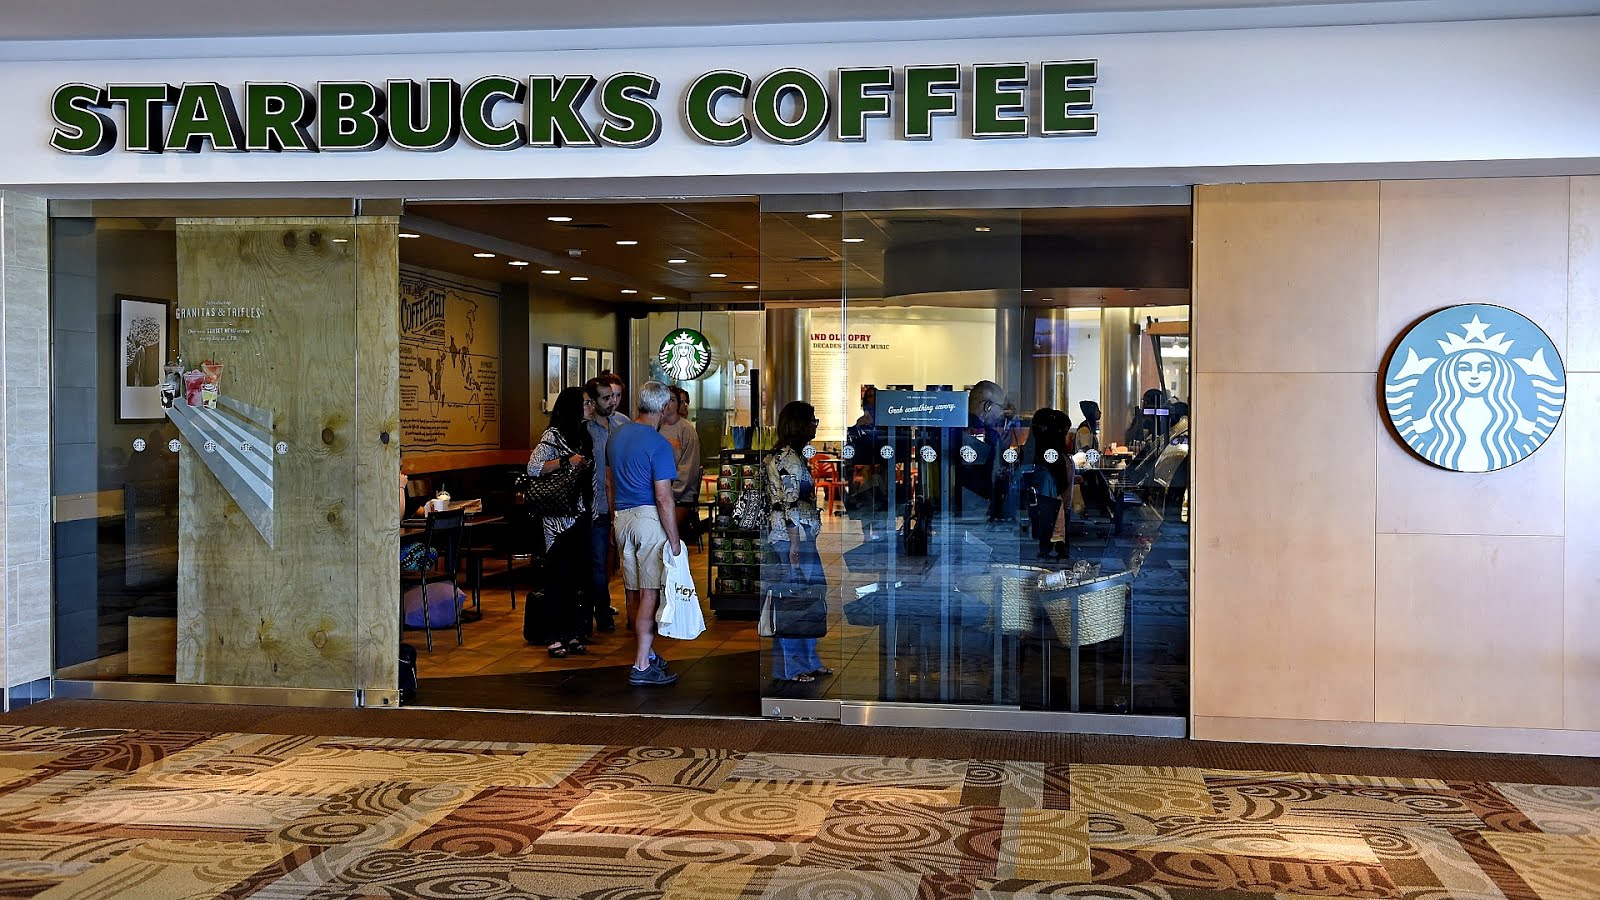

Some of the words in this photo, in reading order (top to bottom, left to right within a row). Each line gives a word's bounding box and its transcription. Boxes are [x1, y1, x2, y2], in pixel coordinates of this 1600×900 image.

[49, 72, 660, 153] STARBUCKS
[684, 59, 1098, 145] COFFEE
[175, 307, 216, 320] GRANITAS
[217, 307, 226, 317] &
[227, 307, 261, 319] TRIFLES
[848, 334, 871, 342] OPRY
[887, 405, 904, 415] Grab
[904, 403, 934, 414] something
